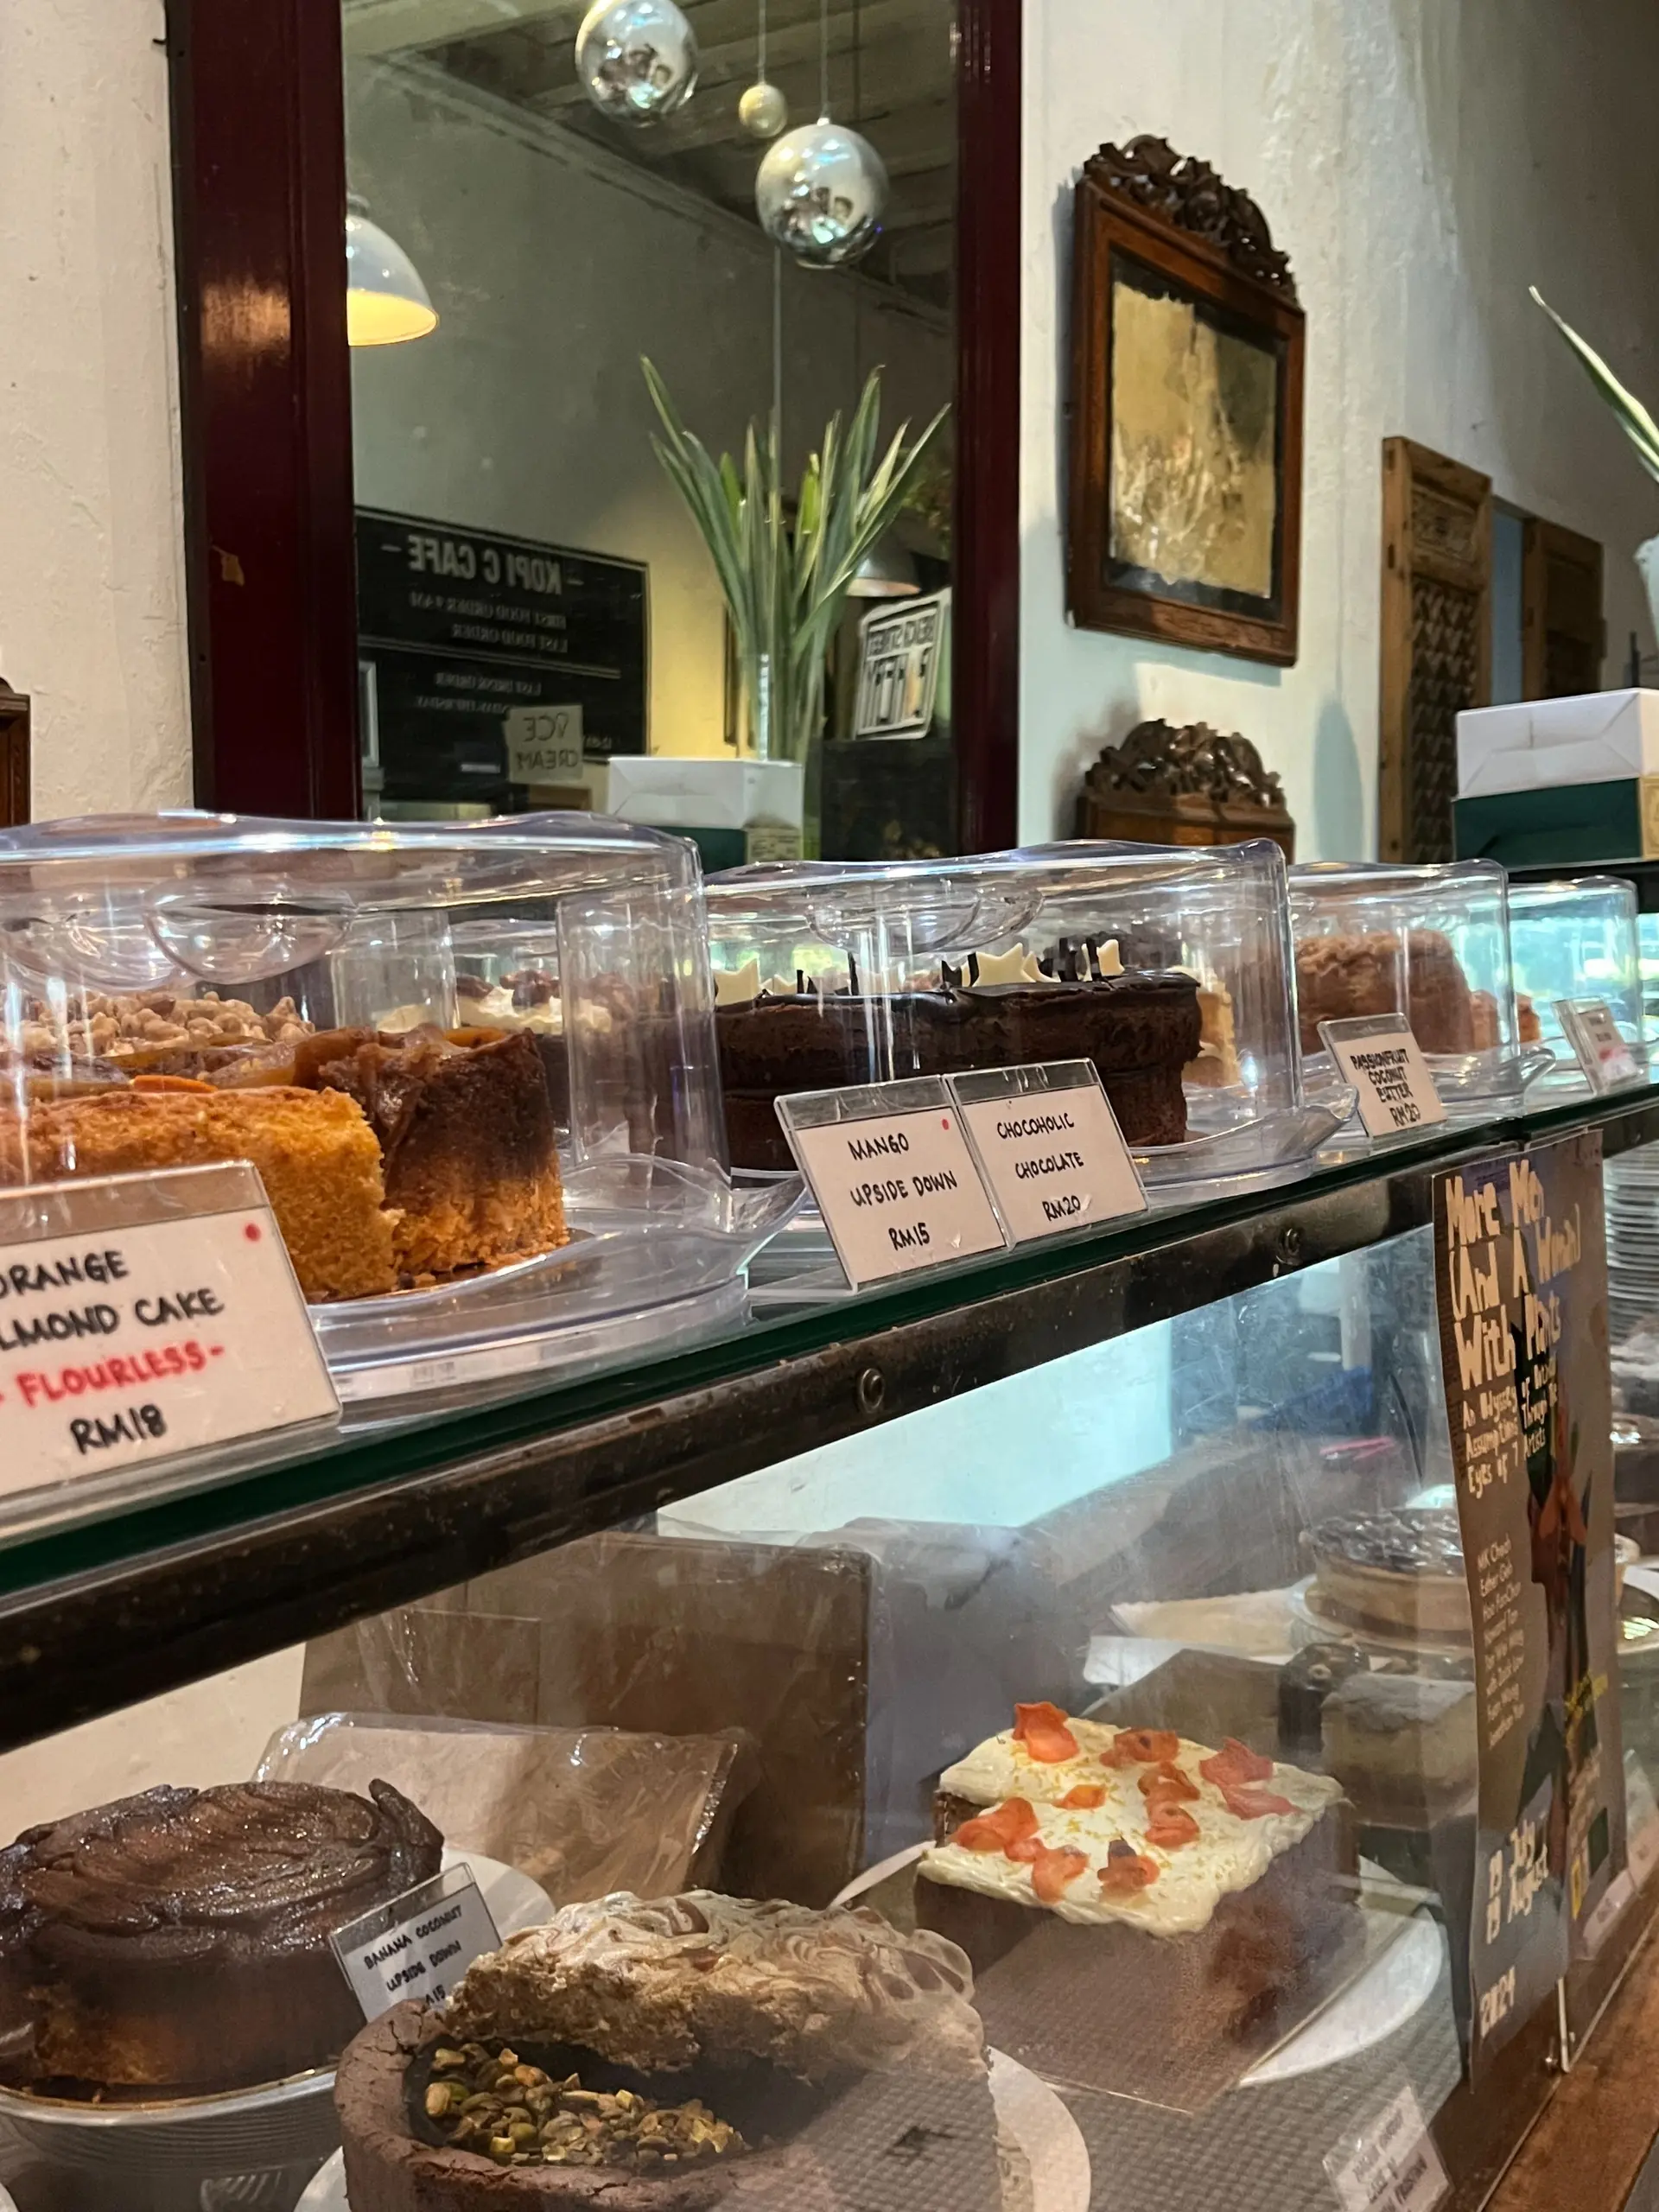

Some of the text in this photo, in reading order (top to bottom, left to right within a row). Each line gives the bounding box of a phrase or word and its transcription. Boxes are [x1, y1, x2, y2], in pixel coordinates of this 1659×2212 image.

[995, 1113, 1076, 1141] CHOCOHOLIC
[1389, 1103, 1421, 1128] RM20
[848, 1132, 910, 1161] MANGO
[1014, 1151, 1084, 1180] CHOCOLATE
[849, 1171, 958, 1207] UPSIDE DOWN
[1041, 1194, 1082, 1222] RM20
[1446, 1175, 1501, 1250] More
[887, 1222, 931, 1251] RM15
[1514, 1230, 1529, 1298] A
[0, 1287, 226, 1351] LMOND CAKE
[1454, 1304, 1516, 1391] With
[68, 1402, 168, 1456] RM18
[1467, 1463, 1493, 1499] Eyes
[364, 1934, 412, 1969] BANANA
